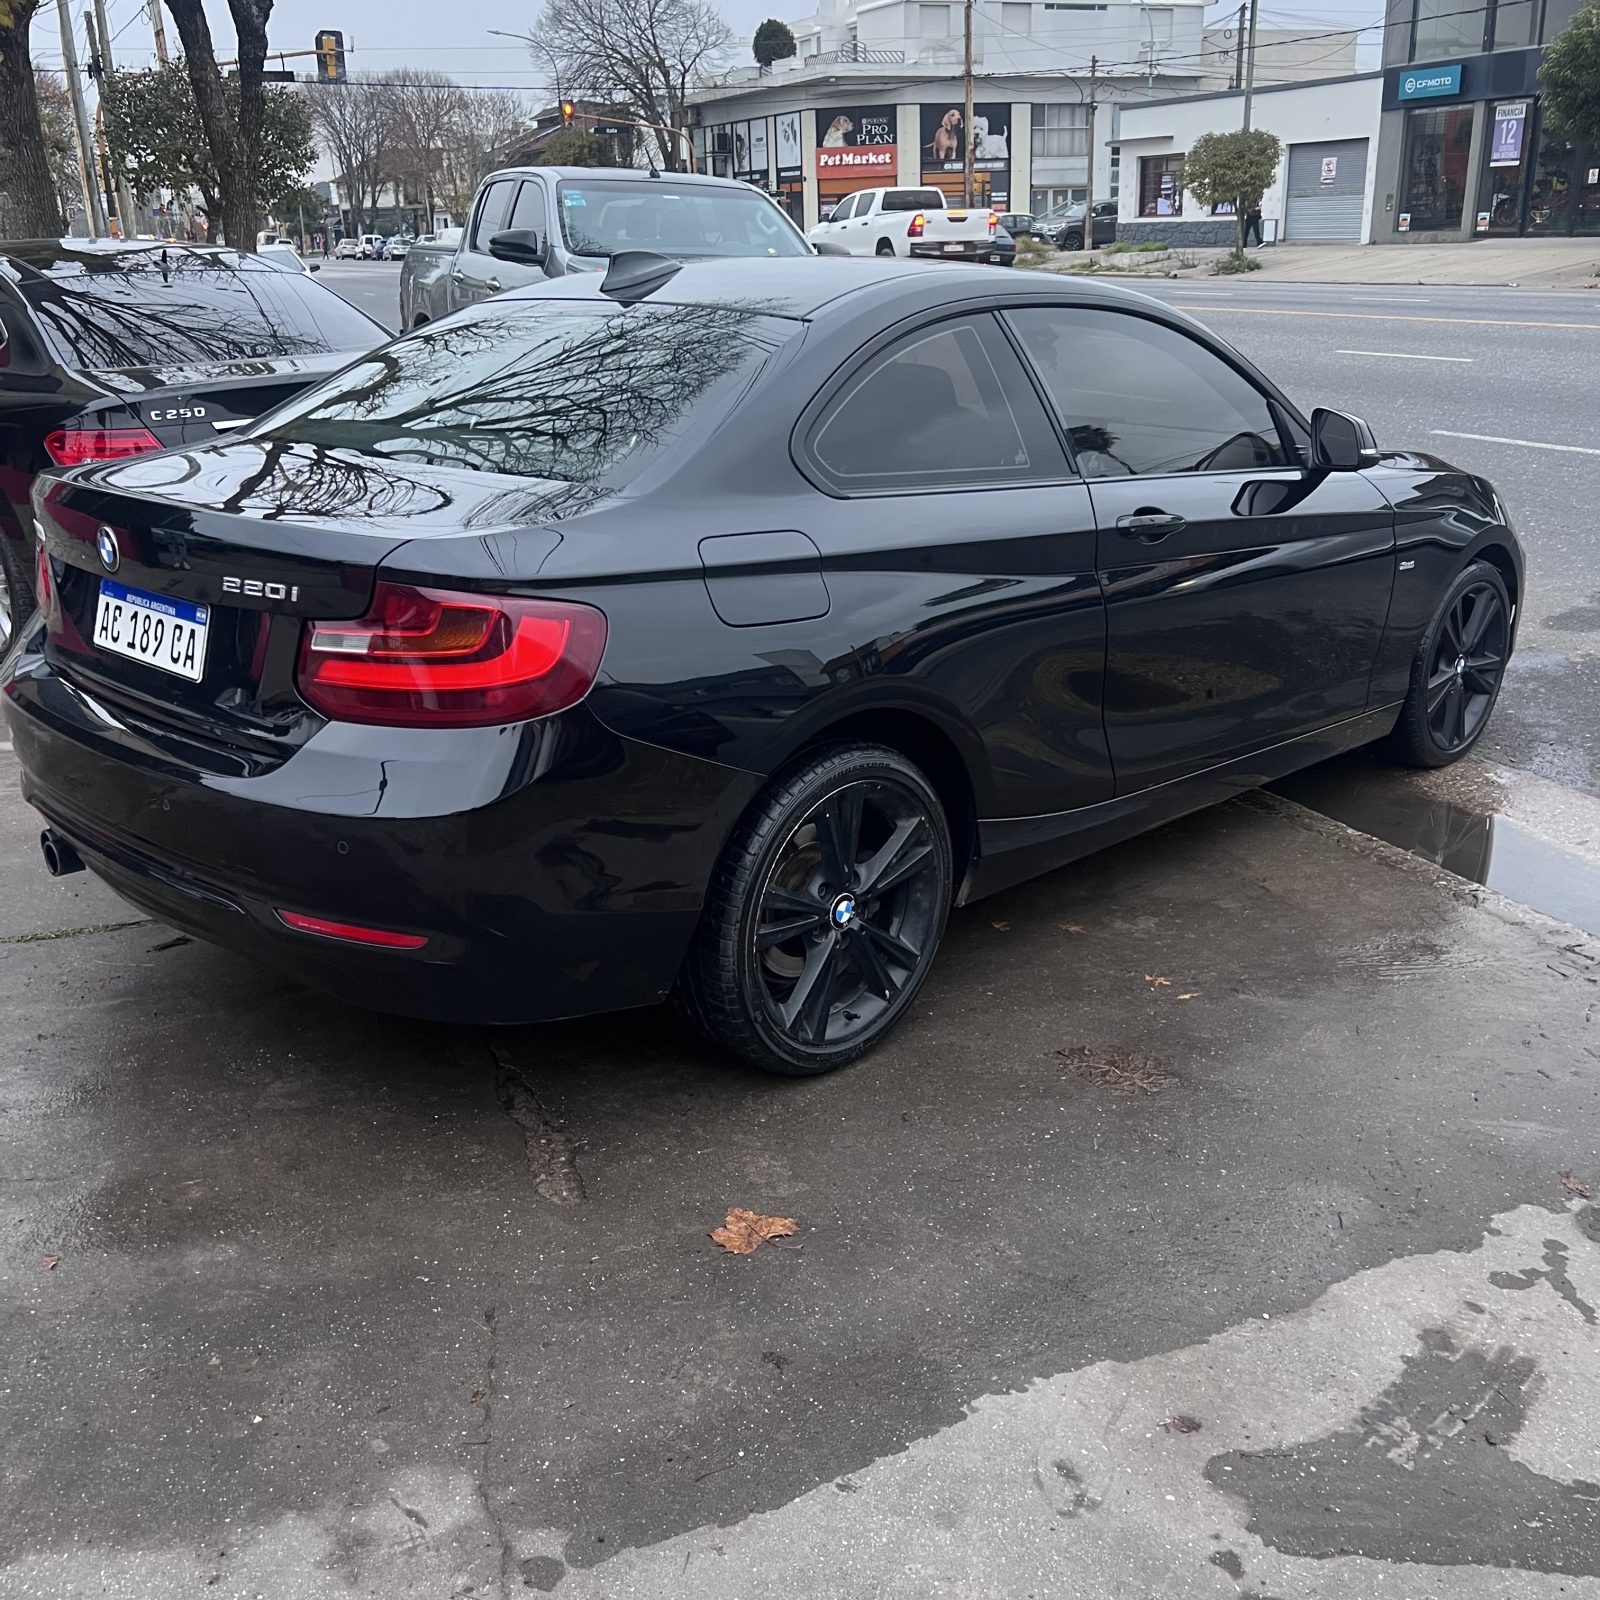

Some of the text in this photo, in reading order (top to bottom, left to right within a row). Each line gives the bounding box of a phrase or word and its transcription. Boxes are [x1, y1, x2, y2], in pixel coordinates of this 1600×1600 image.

[1417, 77, 1452, 88] CFMOTO
[862, 125, 888, 134] PRO
[1501, 120, 1517, 144] 12
[857, 134, 894, 144] PLAN
[819, 152, 891, 166] Pet Market
[150, 407, 206, 420] C 250
[222, 576, 298, 602] 220i
[150, 601, 176, 616] ARGENTINA
[99, 601, 196, 670] AC 189 CA
